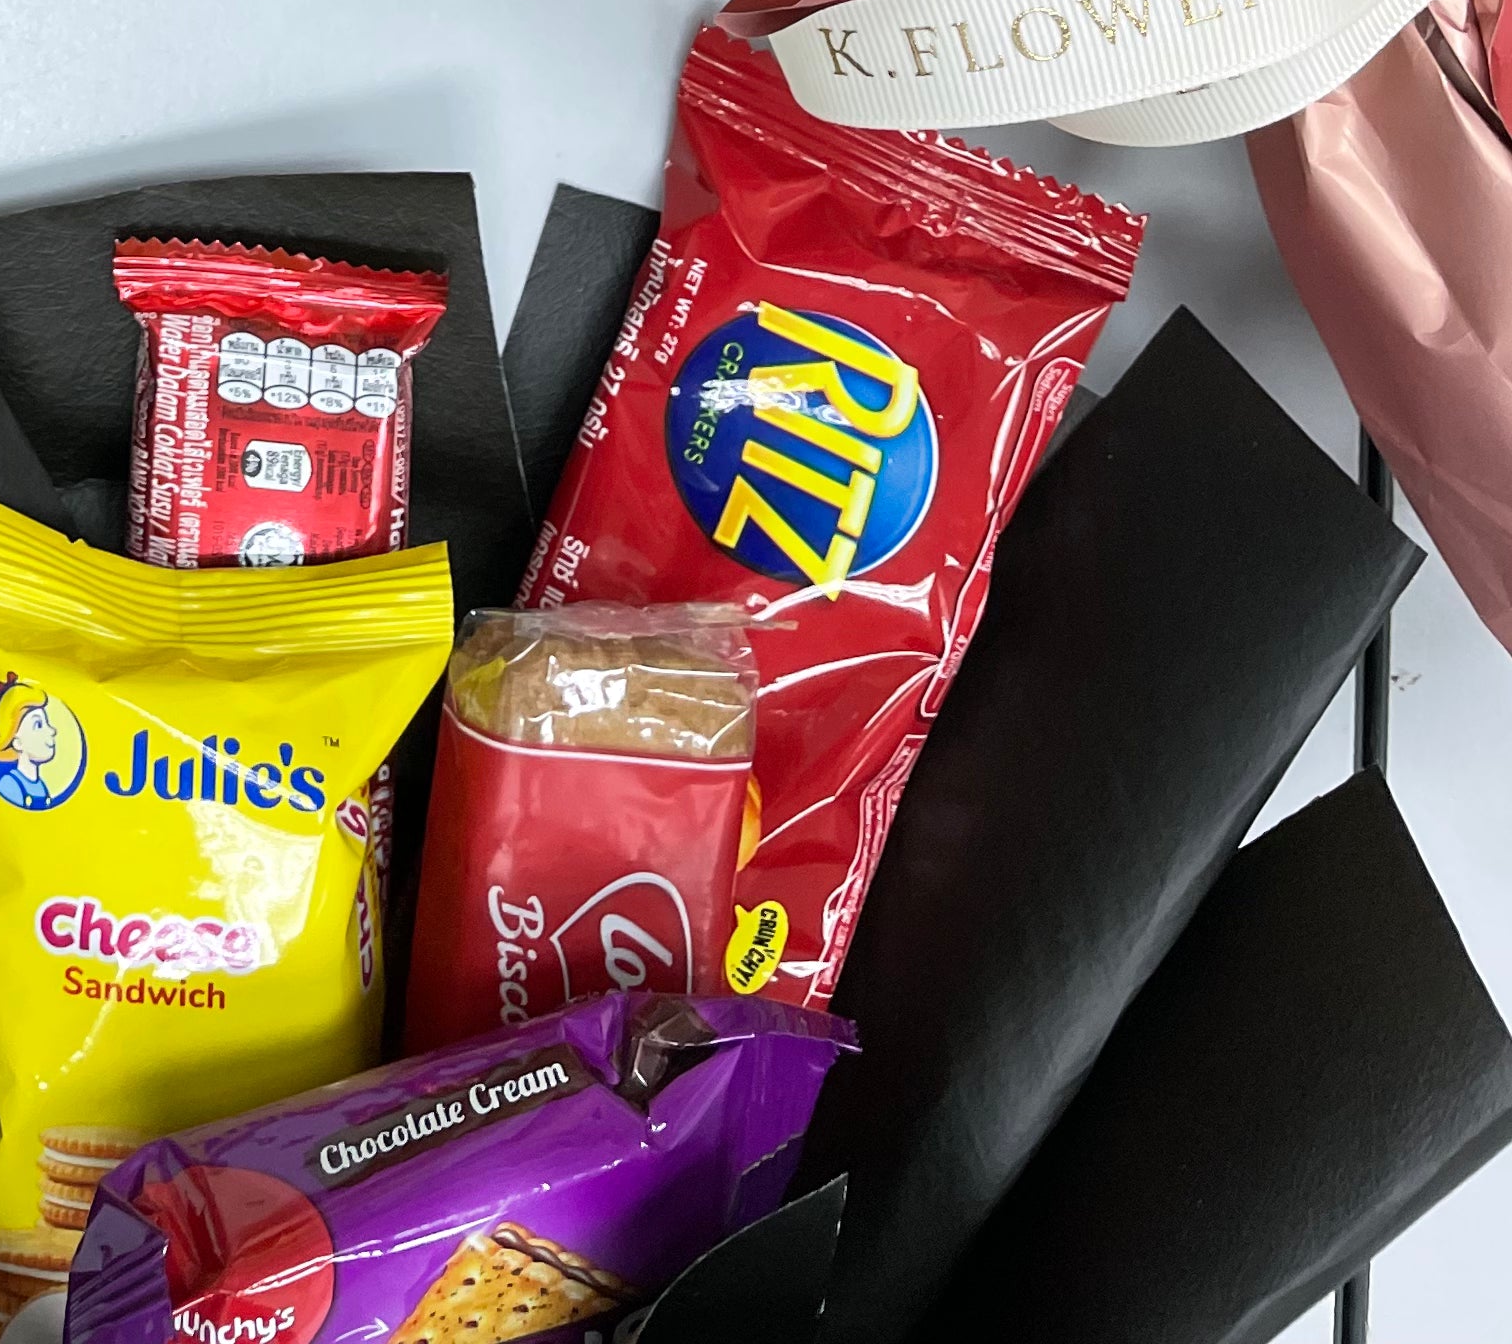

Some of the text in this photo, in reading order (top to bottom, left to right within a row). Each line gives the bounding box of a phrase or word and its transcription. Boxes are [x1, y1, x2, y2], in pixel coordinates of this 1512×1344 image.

[653, 257, 709, 365] NET WT: 27g
[155, 364, 187, 420] Dalam
[152, 425, 183, 484] Coklat
[276, 448, 292, 484] Tenaga
[712, 300, 919, 601] RITZ
[150, 481, 178, 521] Susu
[389, 508, 404, 551] Ha
[104, 729, 326, 812] Julie's
[40, 903, 258, 969] Cheese
[488, 885, 545, 1025] Bisc
[63, 967, 226, 1010] Sandwich
[319, 1059, 569, 1178] Chocolate Cream
